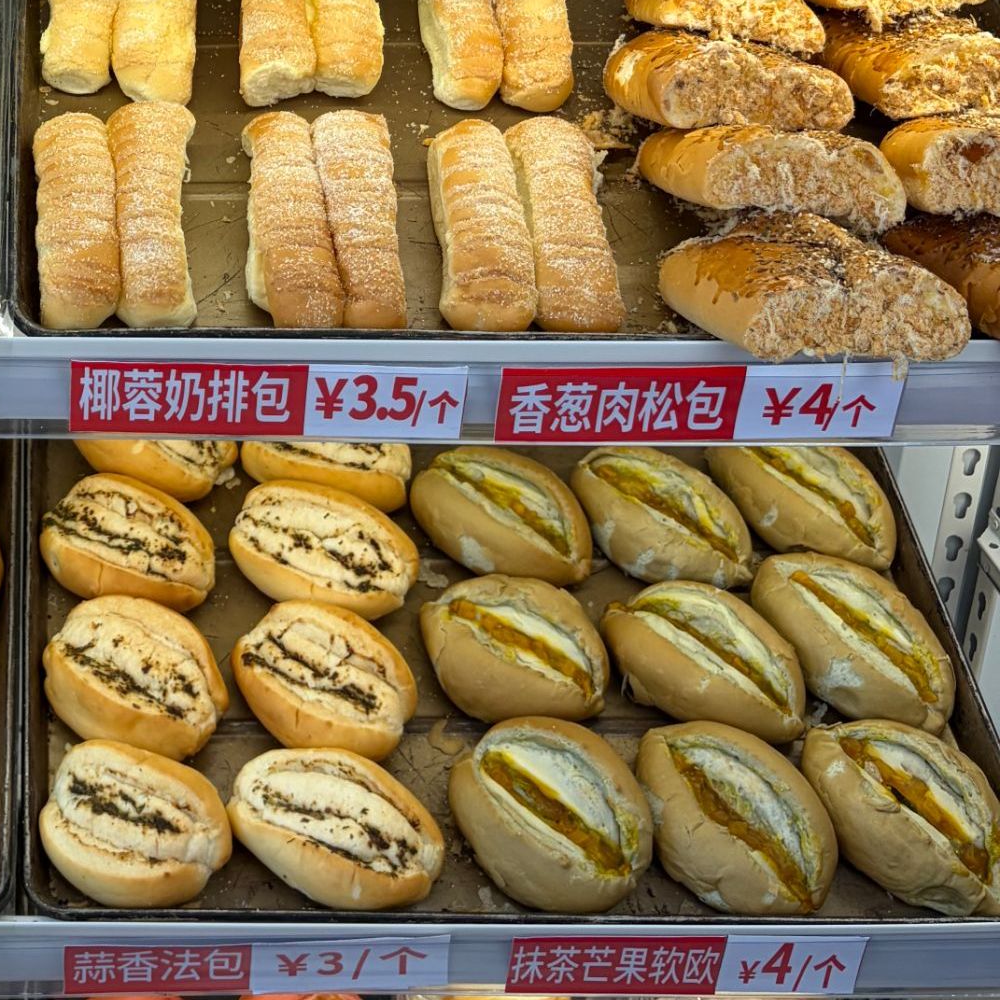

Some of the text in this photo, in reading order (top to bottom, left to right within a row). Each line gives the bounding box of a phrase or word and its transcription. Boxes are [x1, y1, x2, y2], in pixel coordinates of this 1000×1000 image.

[79, 367, 290, 423] 椰蓉奶排包
[510, 381, 725, 433] 香葱肉松包
[74, 949, 244, 984] 蒜香法包
[510, 945, 719, 985] 抹茶芒果软欧
